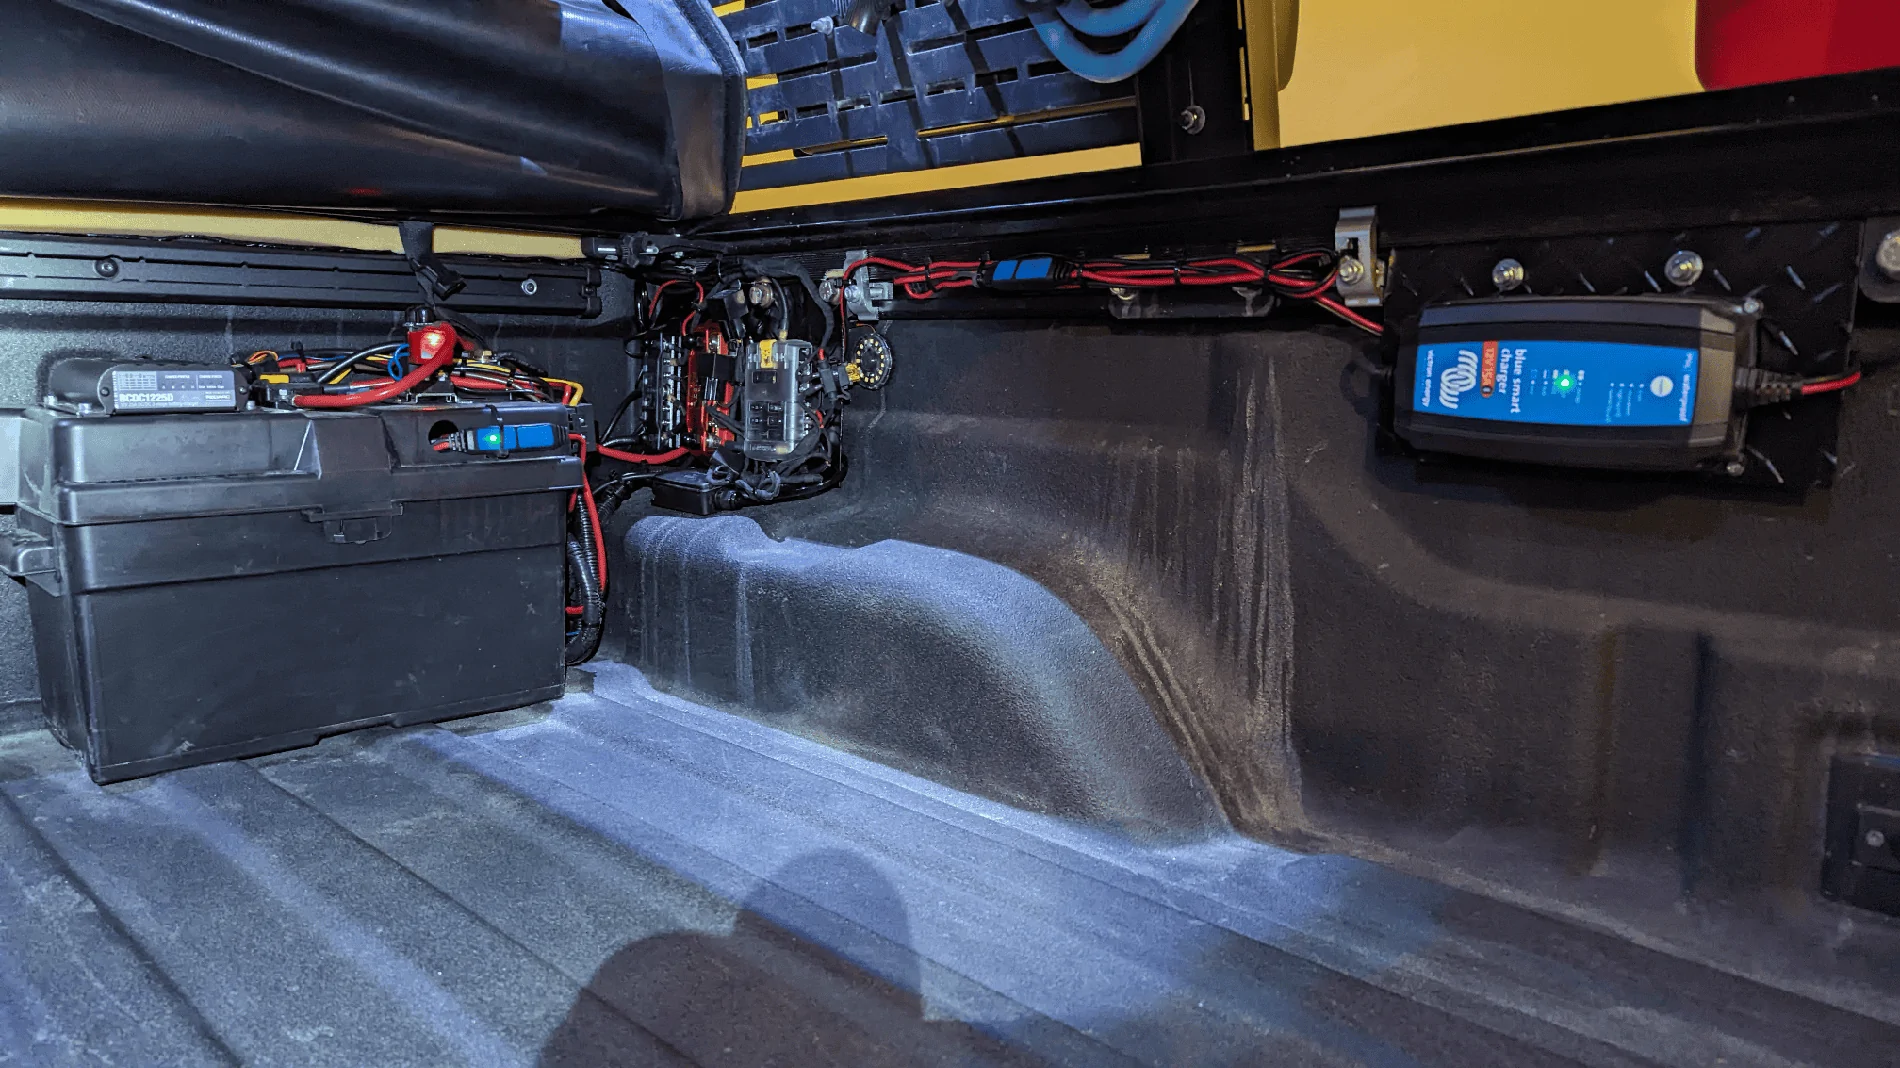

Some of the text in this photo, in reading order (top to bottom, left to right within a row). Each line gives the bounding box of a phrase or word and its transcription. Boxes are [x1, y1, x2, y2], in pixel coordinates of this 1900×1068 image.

[1421, 349, 1434, 408] victron energy
[1496, 348, 1512, 394] charger
[1510, 348, 1527, 414] blue smart
